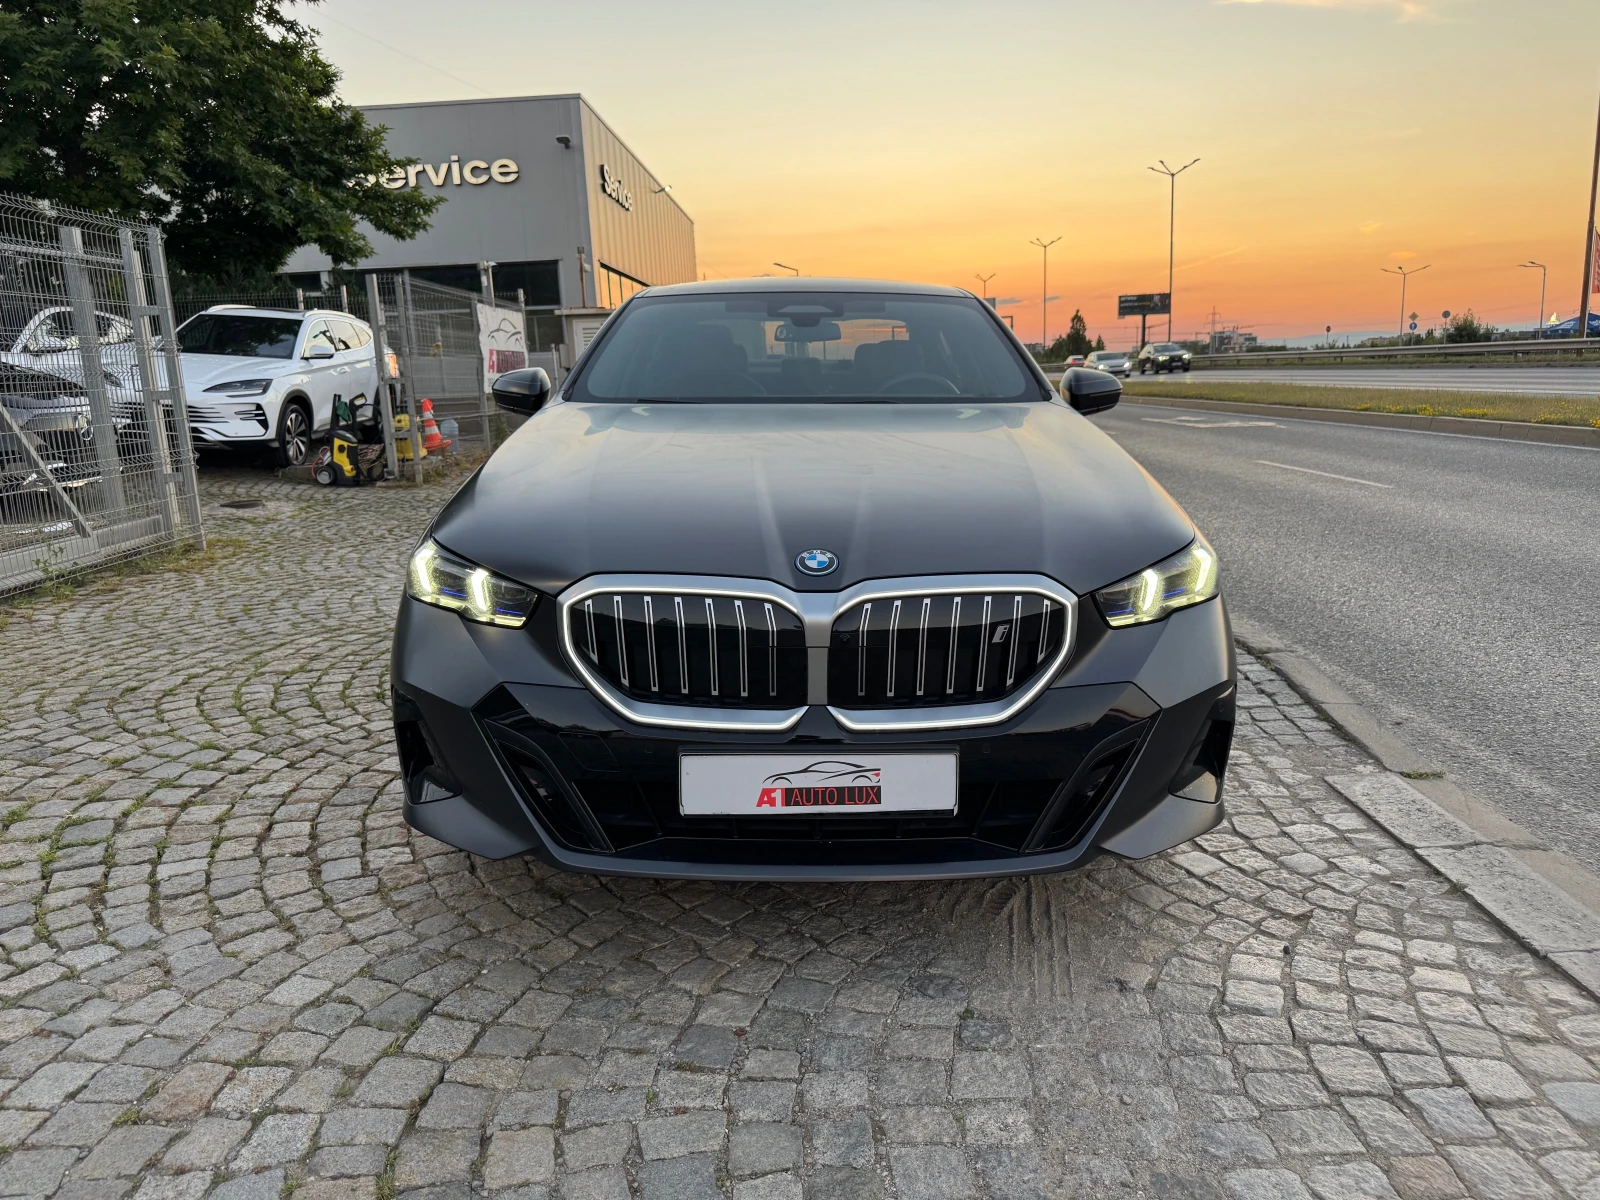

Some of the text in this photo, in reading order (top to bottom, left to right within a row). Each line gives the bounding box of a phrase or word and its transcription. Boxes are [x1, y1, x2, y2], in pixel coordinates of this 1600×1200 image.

[601, 163, 633, 212] Service
[756, 786, 879, 808] A1 AUTO LUX
